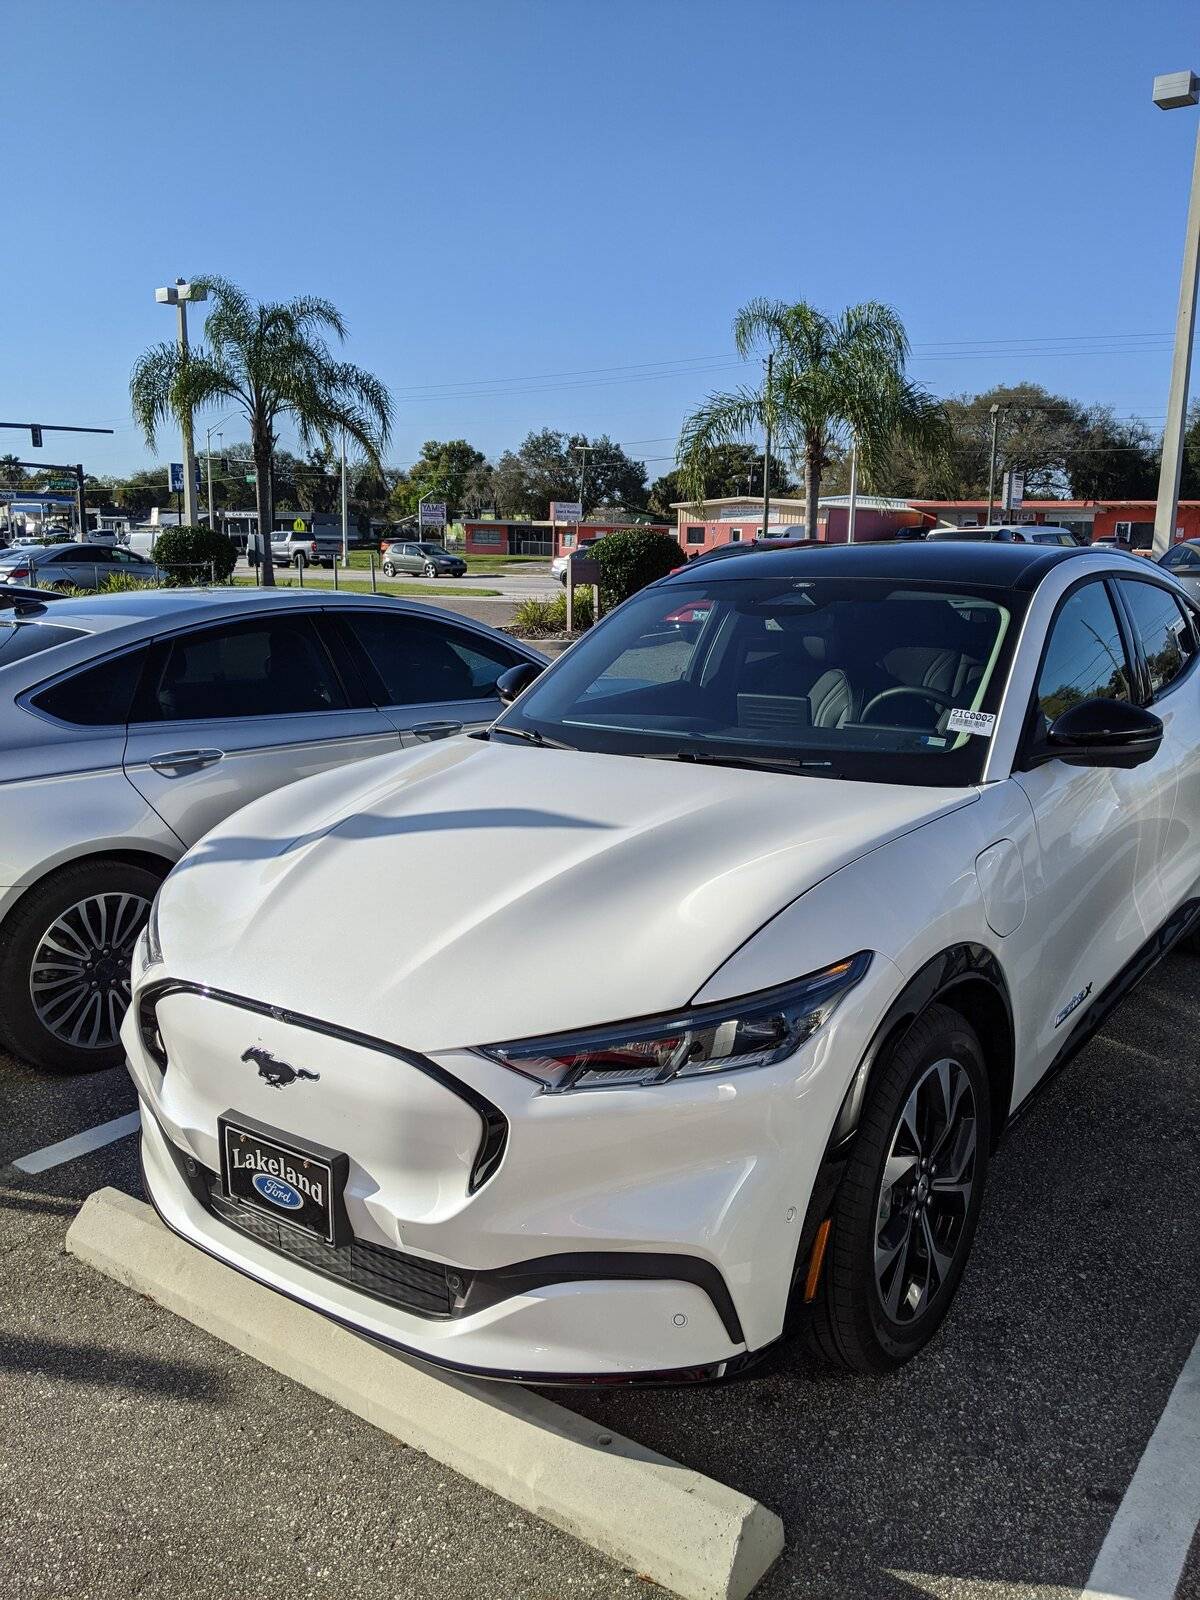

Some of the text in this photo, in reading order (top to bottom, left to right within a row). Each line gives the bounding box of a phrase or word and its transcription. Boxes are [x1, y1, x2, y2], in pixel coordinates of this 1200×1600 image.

[952, 709, 994, 723] 21C0002
[232, 1148, 323, 1206] Lakeland
[264, 1179, 291, 1203] Ford
